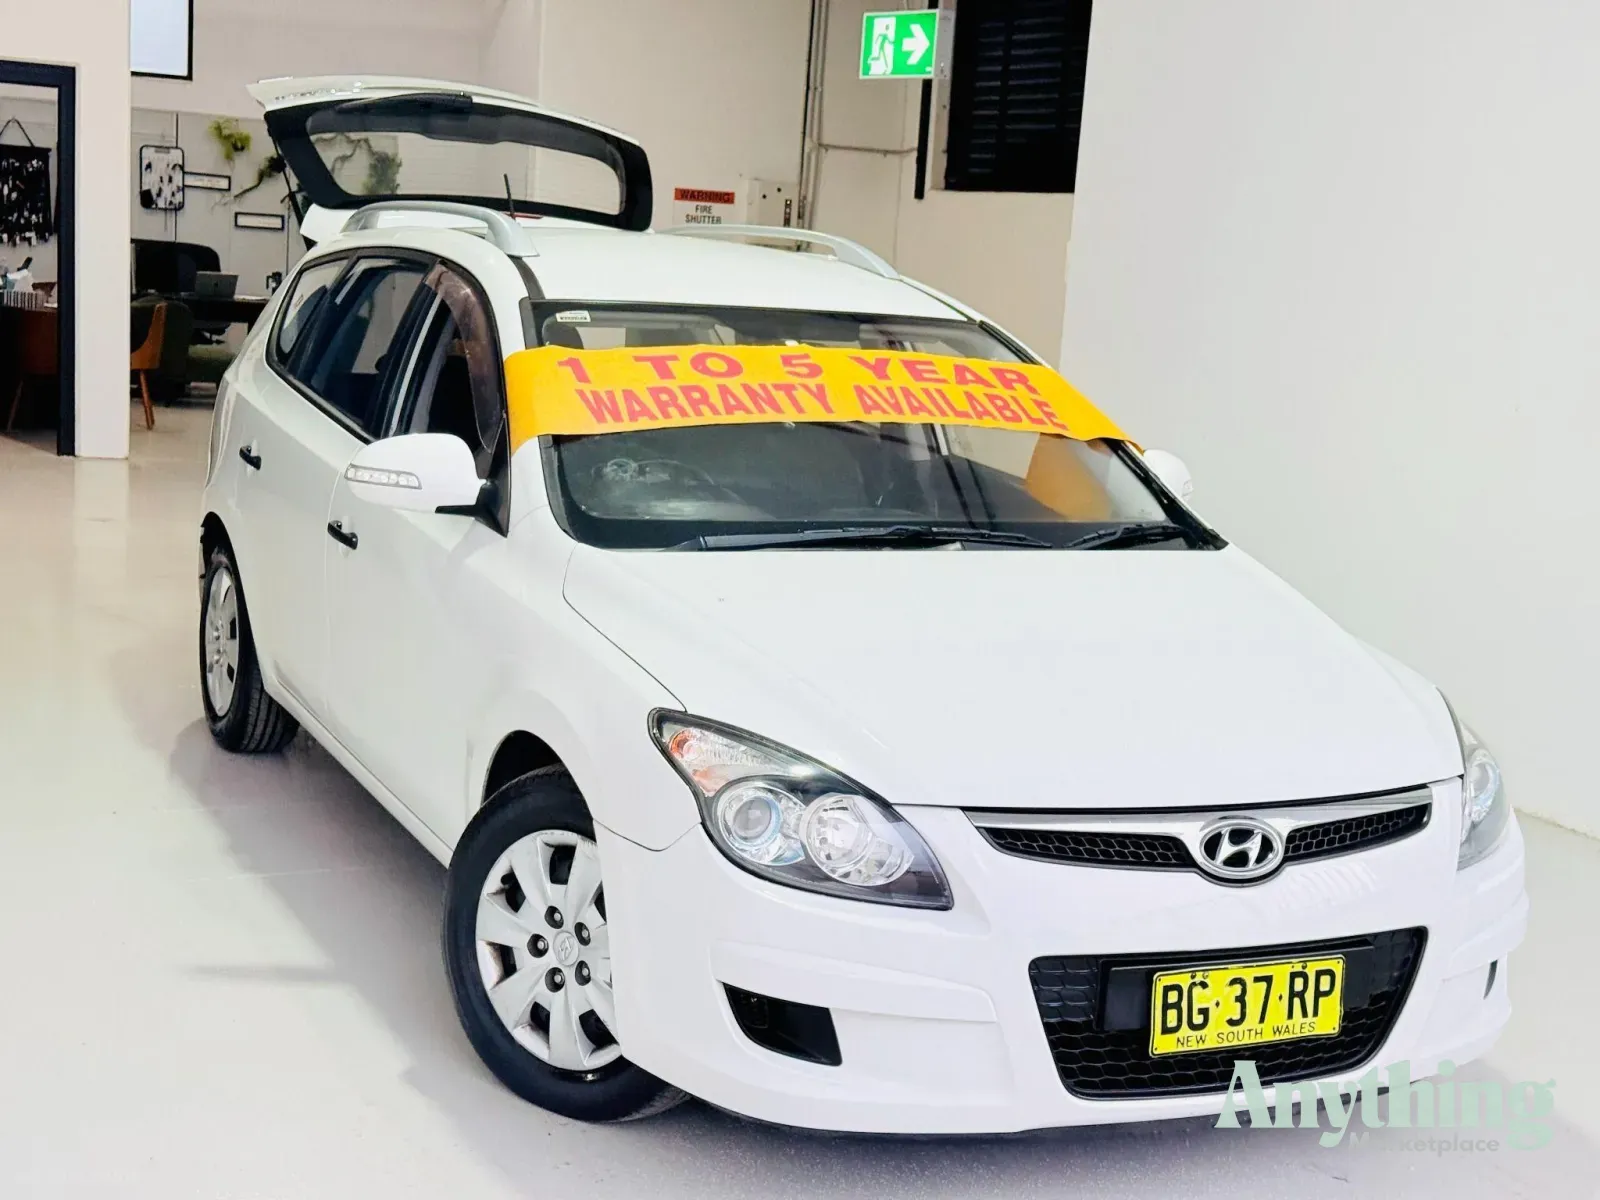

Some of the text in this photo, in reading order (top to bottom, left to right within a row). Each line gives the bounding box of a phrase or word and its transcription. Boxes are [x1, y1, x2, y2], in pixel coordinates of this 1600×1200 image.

[680, 189, 731, 203] WARNING
[685, 214, 722, 225] SHUTTER
[695, 204, 713, 214] FIRE
[557, 351, 1040, 396] 1 TO 5 YEAR
[575, 382, 1069, 431] WARRANTY AVAILABLE
[1176, 1020, 1316, 1049] NEW SOUTH WALES
